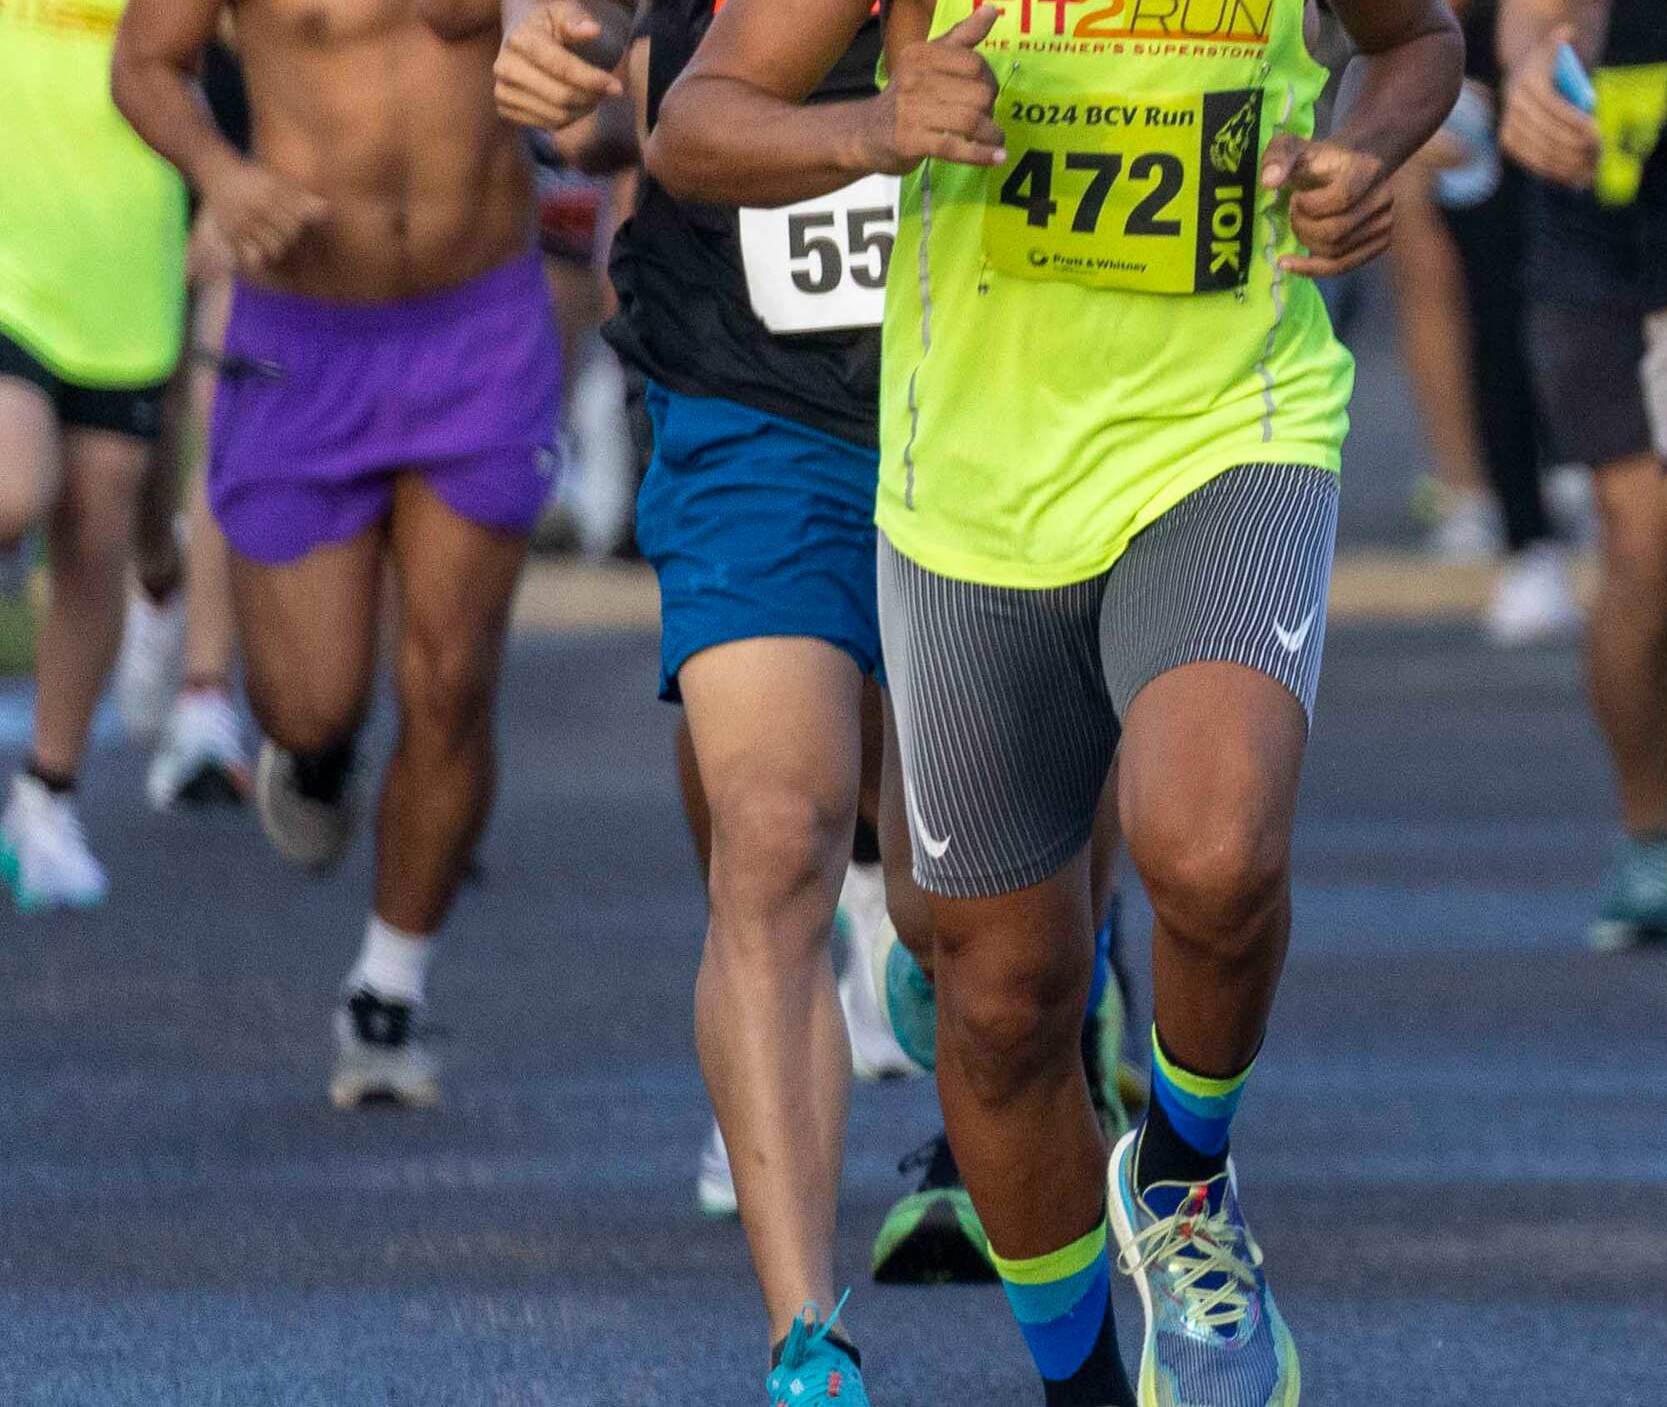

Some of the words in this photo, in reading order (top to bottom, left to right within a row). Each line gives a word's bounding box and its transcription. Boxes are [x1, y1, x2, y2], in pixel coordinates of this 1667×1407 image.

[982, 39, 1010, 52] HE
[1018, 40, 1124, 55] RUNNER'S
[1134, 43, 1266, 60] SUPERSTORE
[1012, 101, 1078, 124] 2024
[1086, 104, 1138, 126] BCV
[1145, 107, 1195, 127] Run
[1000, 148, 1185, 237] 472
